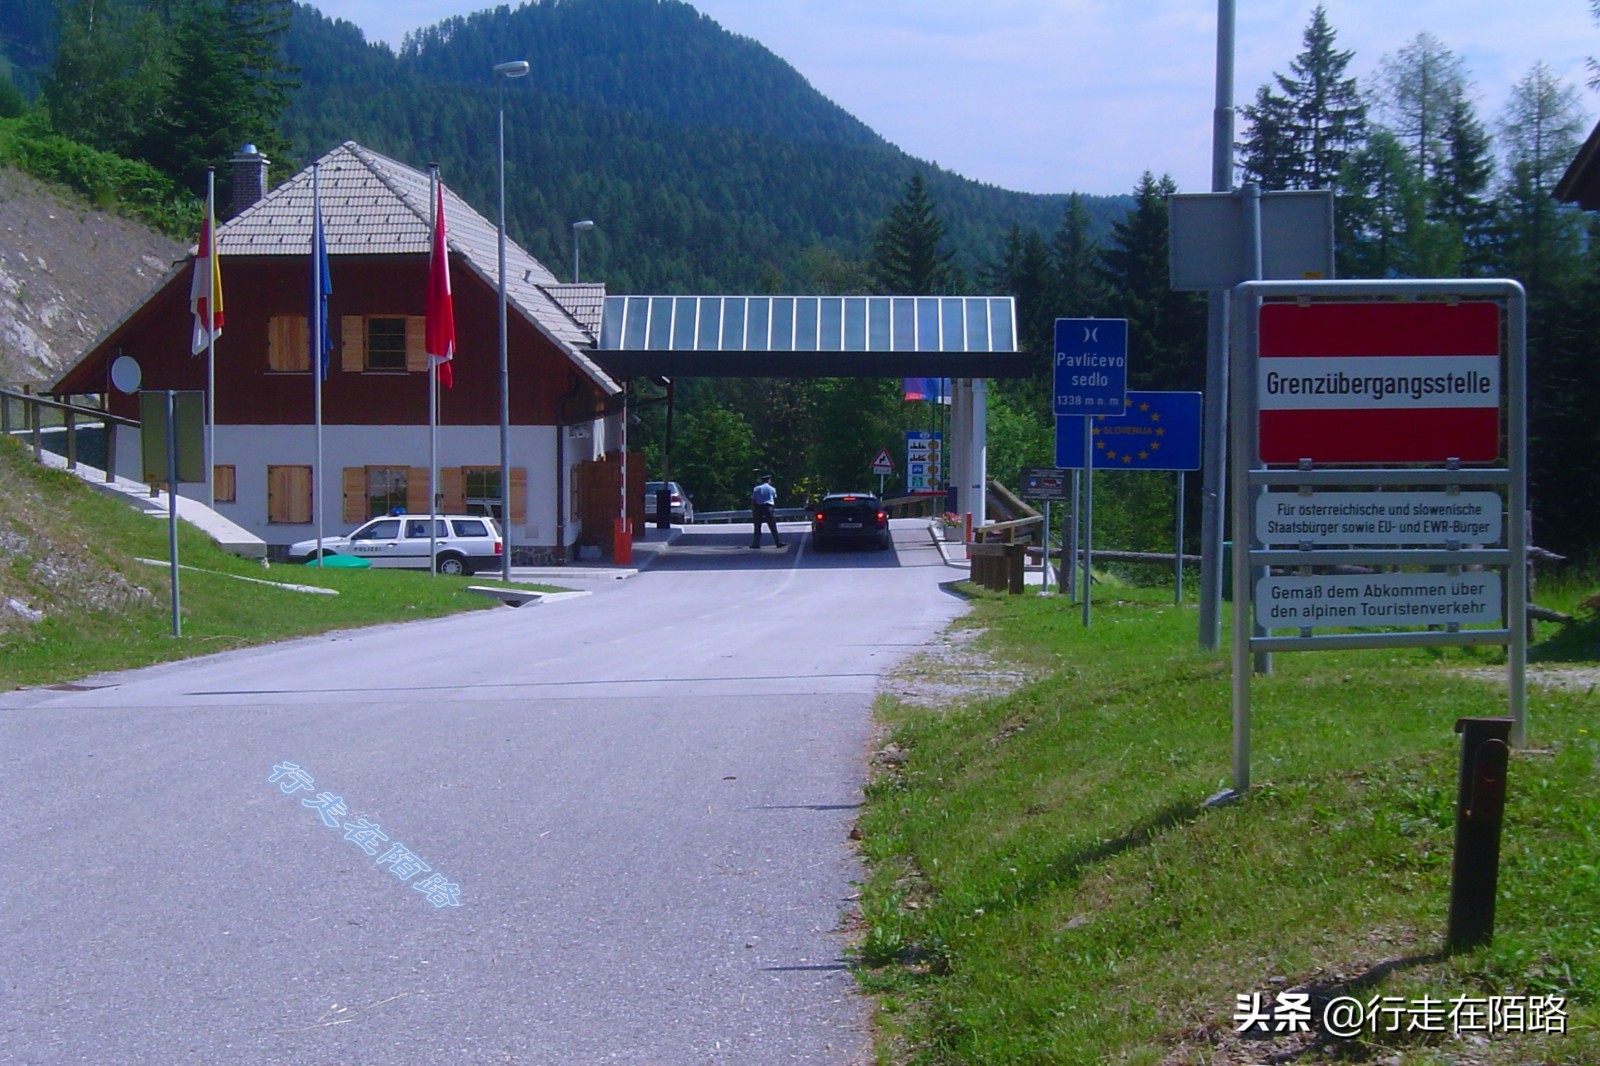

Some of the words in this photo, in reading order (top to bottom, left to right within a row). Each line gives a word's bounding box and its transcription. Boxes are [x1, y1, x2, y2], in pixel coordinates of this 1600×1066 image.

[1056, 352, 1125, 367] Pavličevo
[1071, 372, 1108, 386] sedlo
[1266, 371, 1491, 400] Grenzübergangsstelle
[1057, 395, 1082, 405] 1338
[1084, 397, 1094, 405] m
[1103, 426, 1153, 434] SLOVENIJA
[1277, 503, 1296, 516] Für
[1298, 502, 1385, 516] österreichische
[1388, 503, 1410, 516] und
[1412, 502, 1482, 516] slowenische
[1267, 520, 1338, 536] Staatsbürger
[1342, 521, 1375, 533] sowie
[1378, 521, 1396, 533] EU-
[1399, 521, 1420, 533] und
[1423, 520, 1490, 536] EWR-Bürger
[1271, 585, 1323, 600] Gemäß
[1327, 585, 1359, 599] dem
[1363, 583, 1447, 598] Abkommen
[1451, 582, 1486, 596] über
[1271, 605, 1298, 618] den
[1302, 603, 1356, 620] alpinen
[1360, 600, 1487, 616] Touristenverkehr
